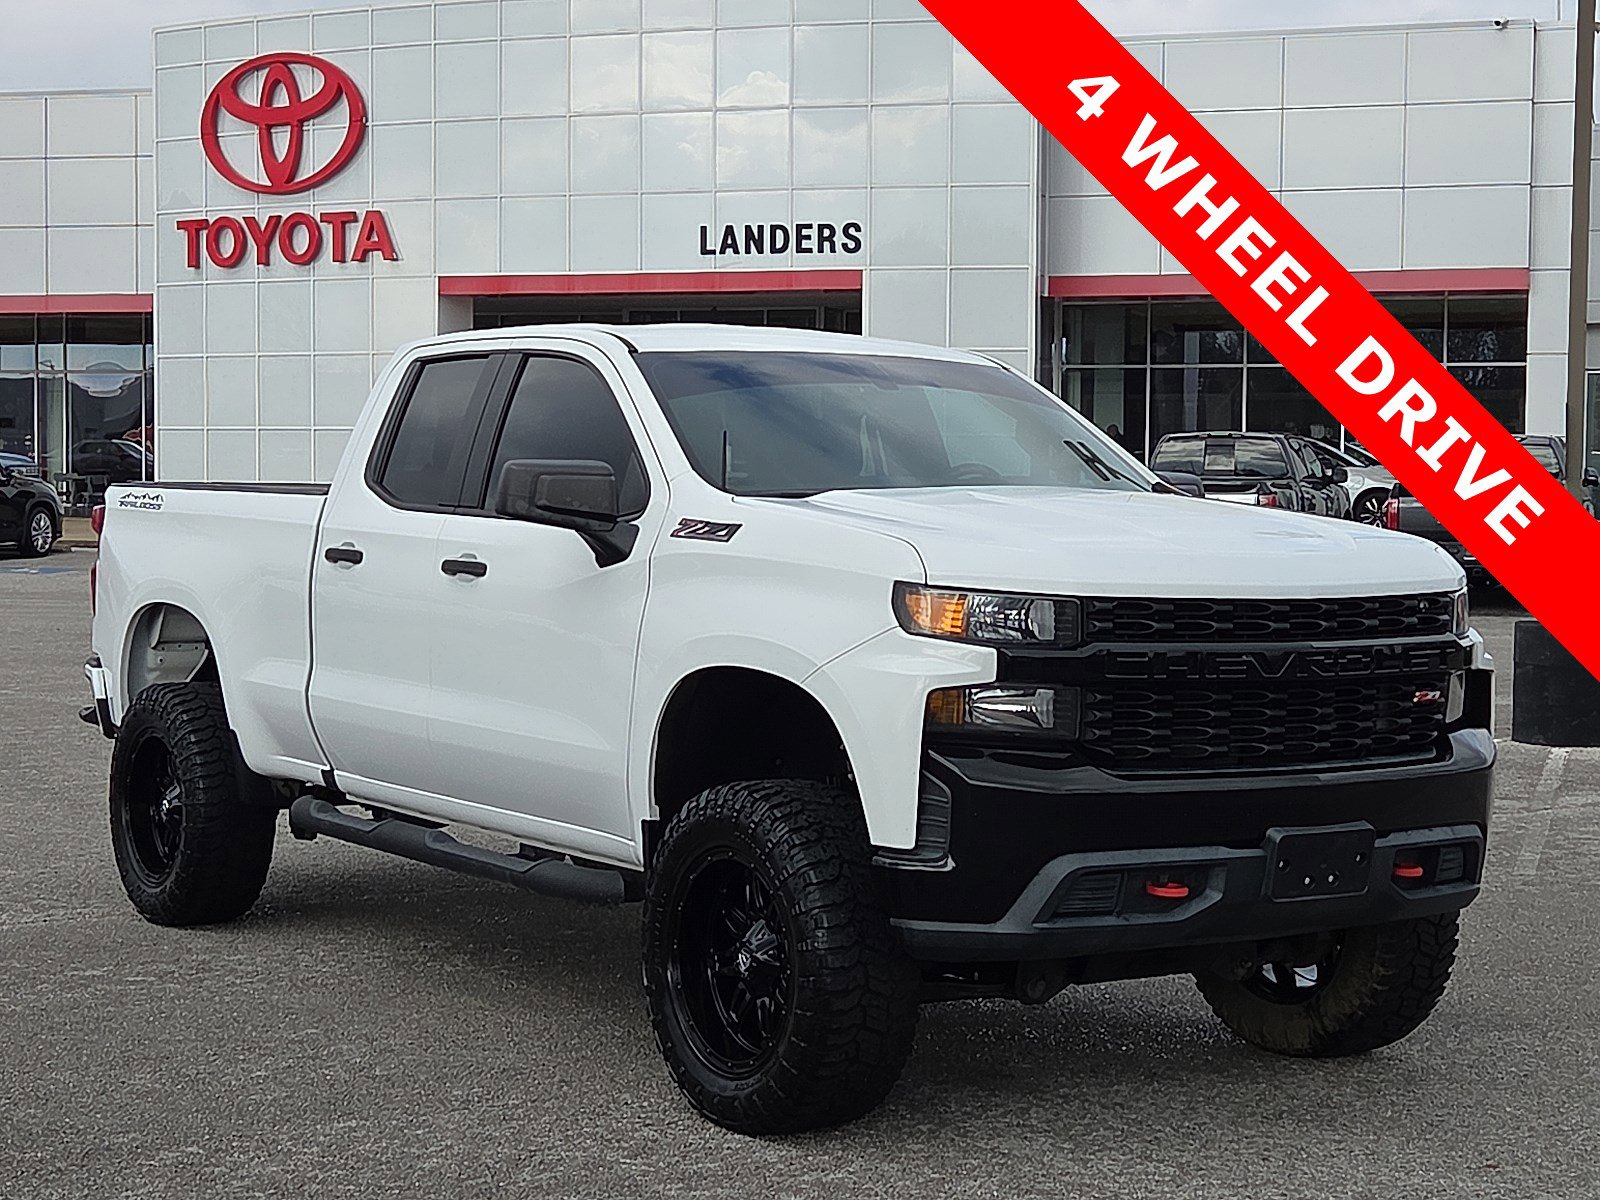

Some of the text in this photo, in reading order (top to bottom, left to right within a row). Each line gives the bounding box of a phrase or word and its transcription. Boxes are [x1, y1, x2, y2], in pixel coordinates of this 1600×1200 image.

[176, 210, 398, 268] TOYOTA
[700, 222, 862, 255] LANDERS
[1104, 647, 1456, 679] CHEVROLET
